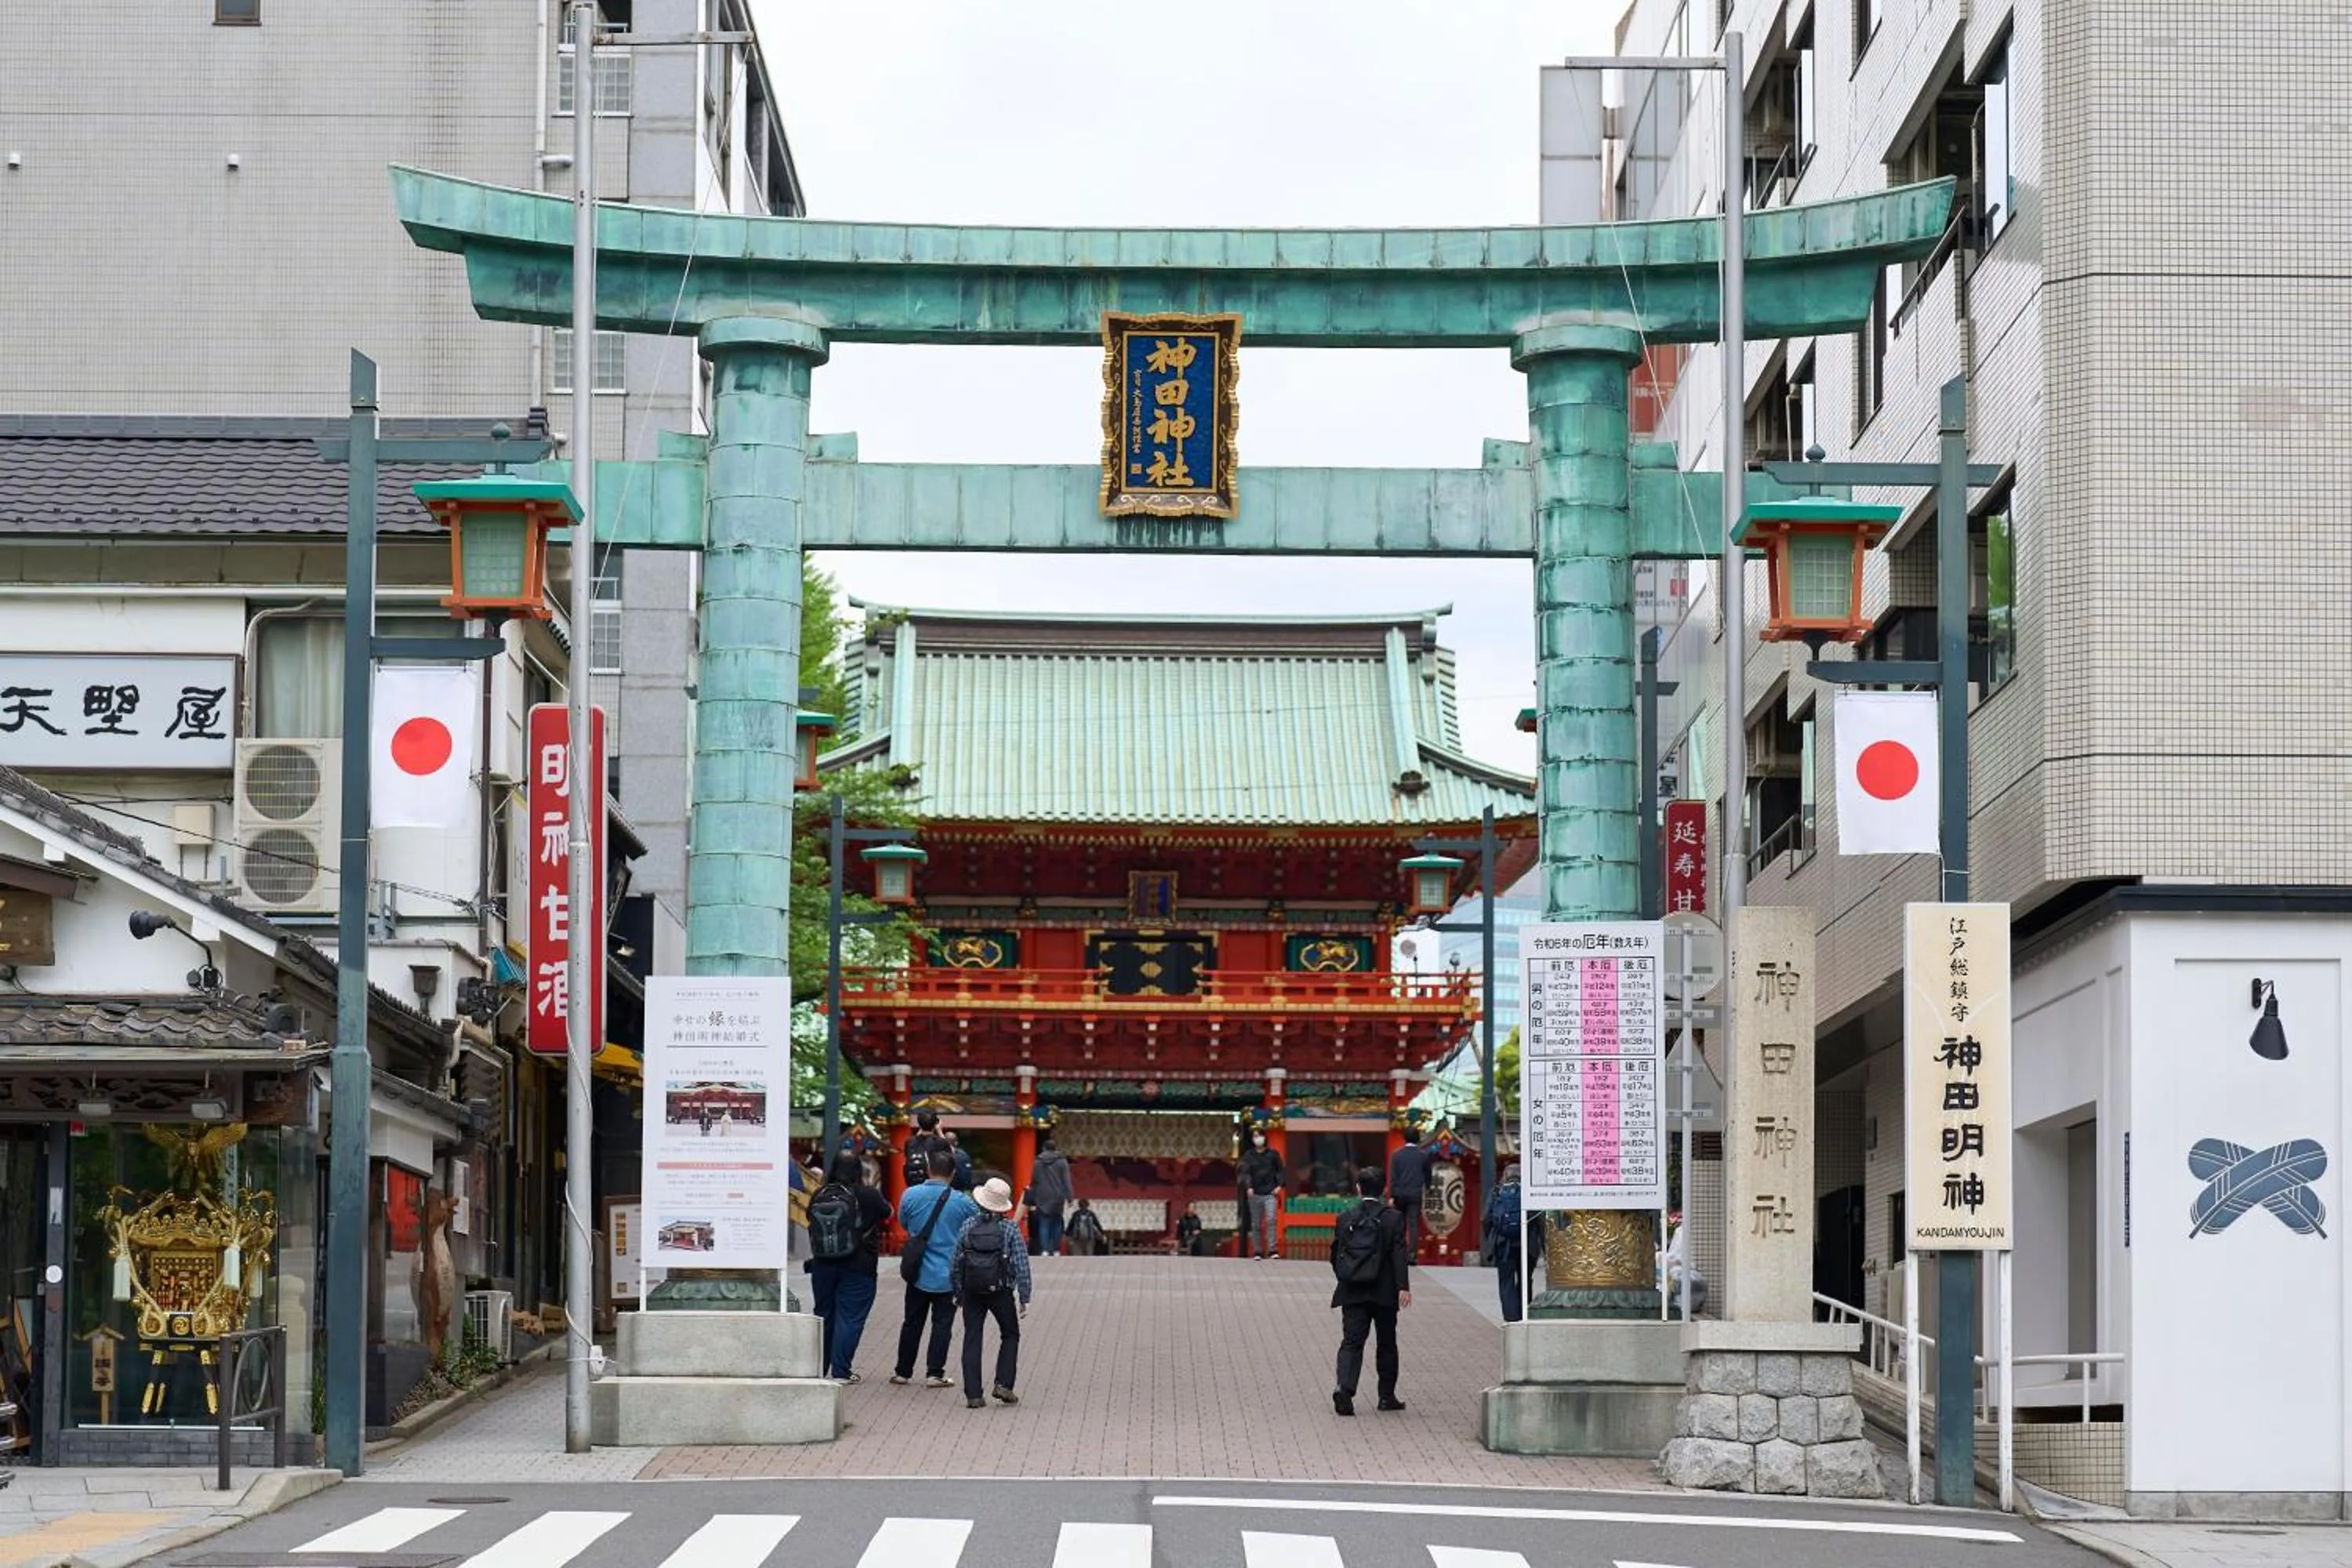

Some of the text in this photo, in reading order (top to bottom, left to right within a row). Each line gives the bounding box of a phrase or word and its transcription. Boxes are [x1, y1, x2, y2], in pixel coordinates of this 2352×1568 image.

[1146, 337, 1197, 487] 神田神社
[0, 685, 227, 739] 天野屋
[1949, 916, 1969, 1022] 江戸総鎮守
[1751, 961, 1801, 1239] 神田神社
[1933, 1035, 1984, 1215] 神田明神
[1917, 1227, 2005, 1239] KANDAMYOUJIN
